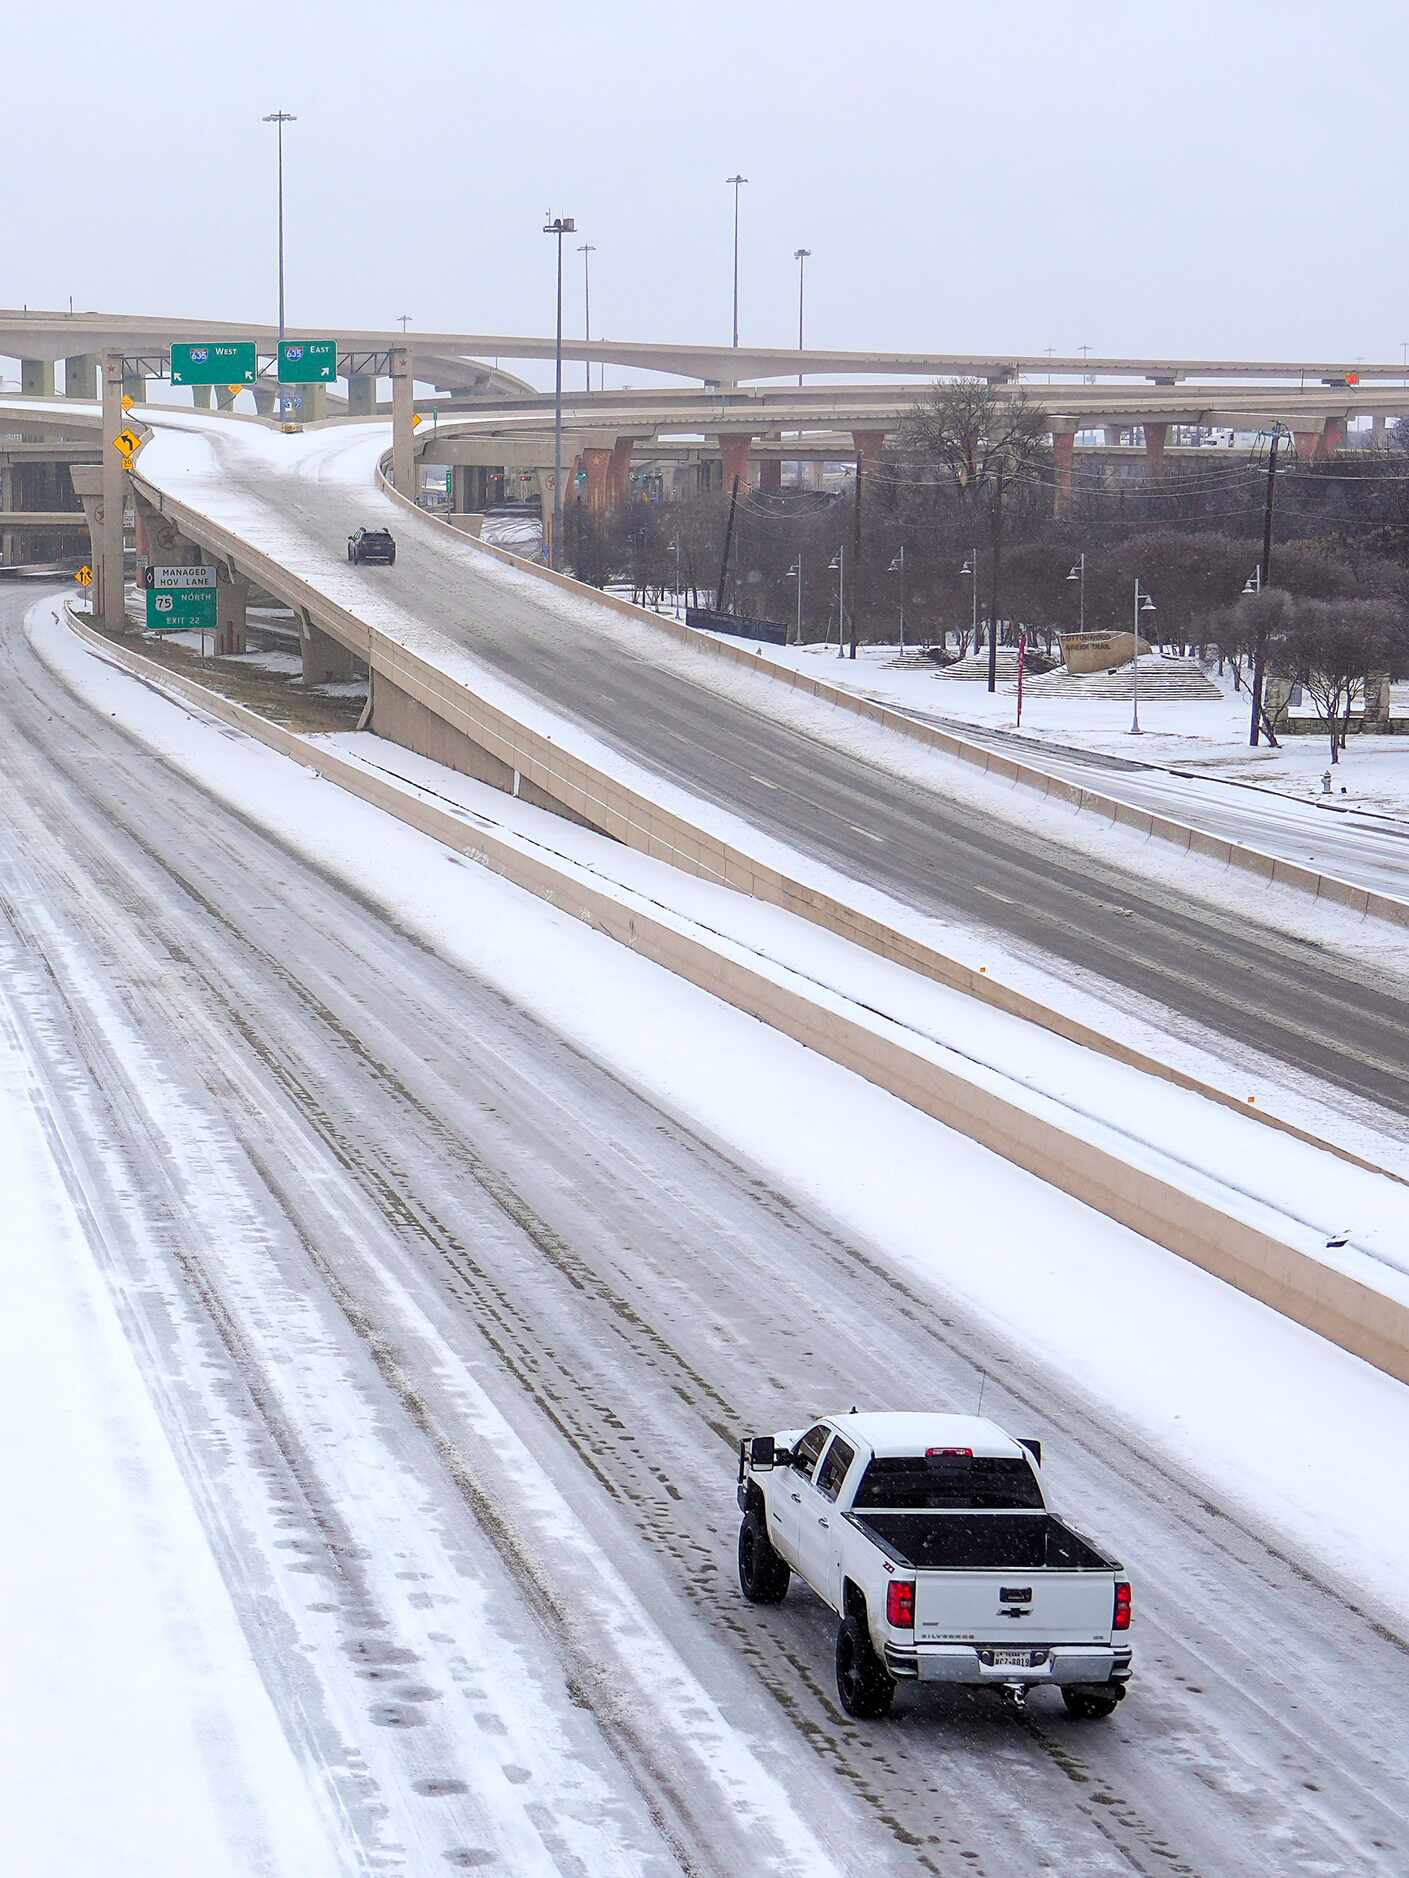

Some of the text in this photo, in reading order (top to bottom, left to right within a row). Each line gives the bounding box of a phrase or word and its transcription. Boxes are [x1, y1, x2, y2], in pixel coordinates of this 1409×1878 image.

[191, 347, 237, 360] 635 WEST
[162, 568, 206, 576] MANAGED
[157, 598, 171, 608] 75
